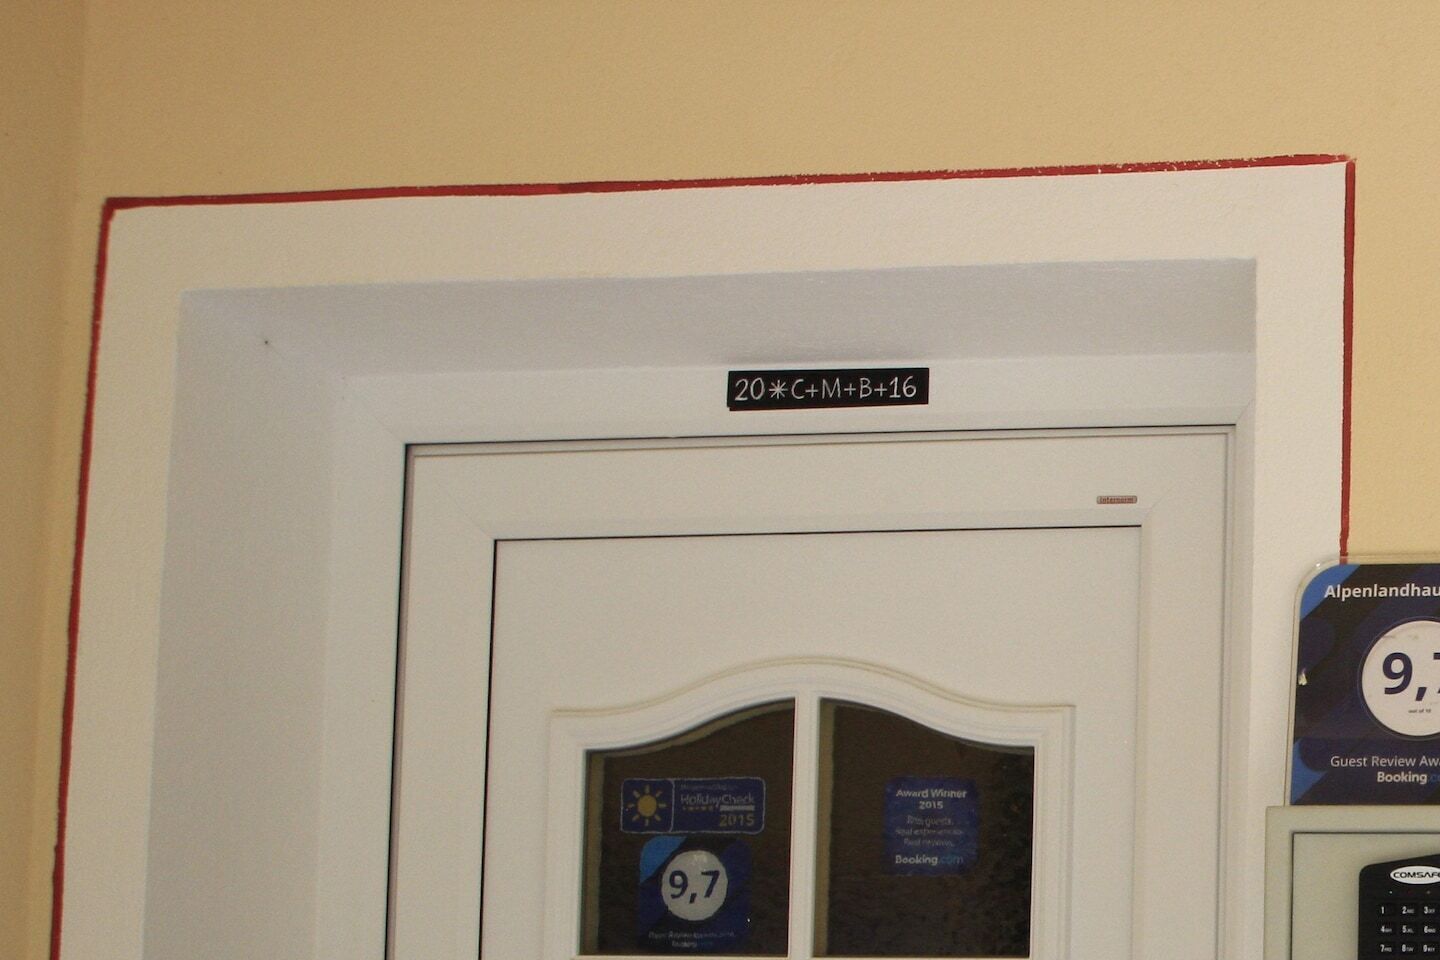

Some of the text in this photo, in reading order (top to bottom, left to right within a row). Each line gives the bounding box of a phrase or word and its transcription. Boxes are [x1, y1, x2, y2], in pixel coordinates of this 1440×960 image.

[1330, 755, 1368, 768] Guest
[1371, 755, 1416, 767] Review
[896, 788, 968, 798] Award Winner
[918, 800, 944, 810] 2015
[719, 813, 755, 827] 2015
[669, 870, 721, 904] 9,7
